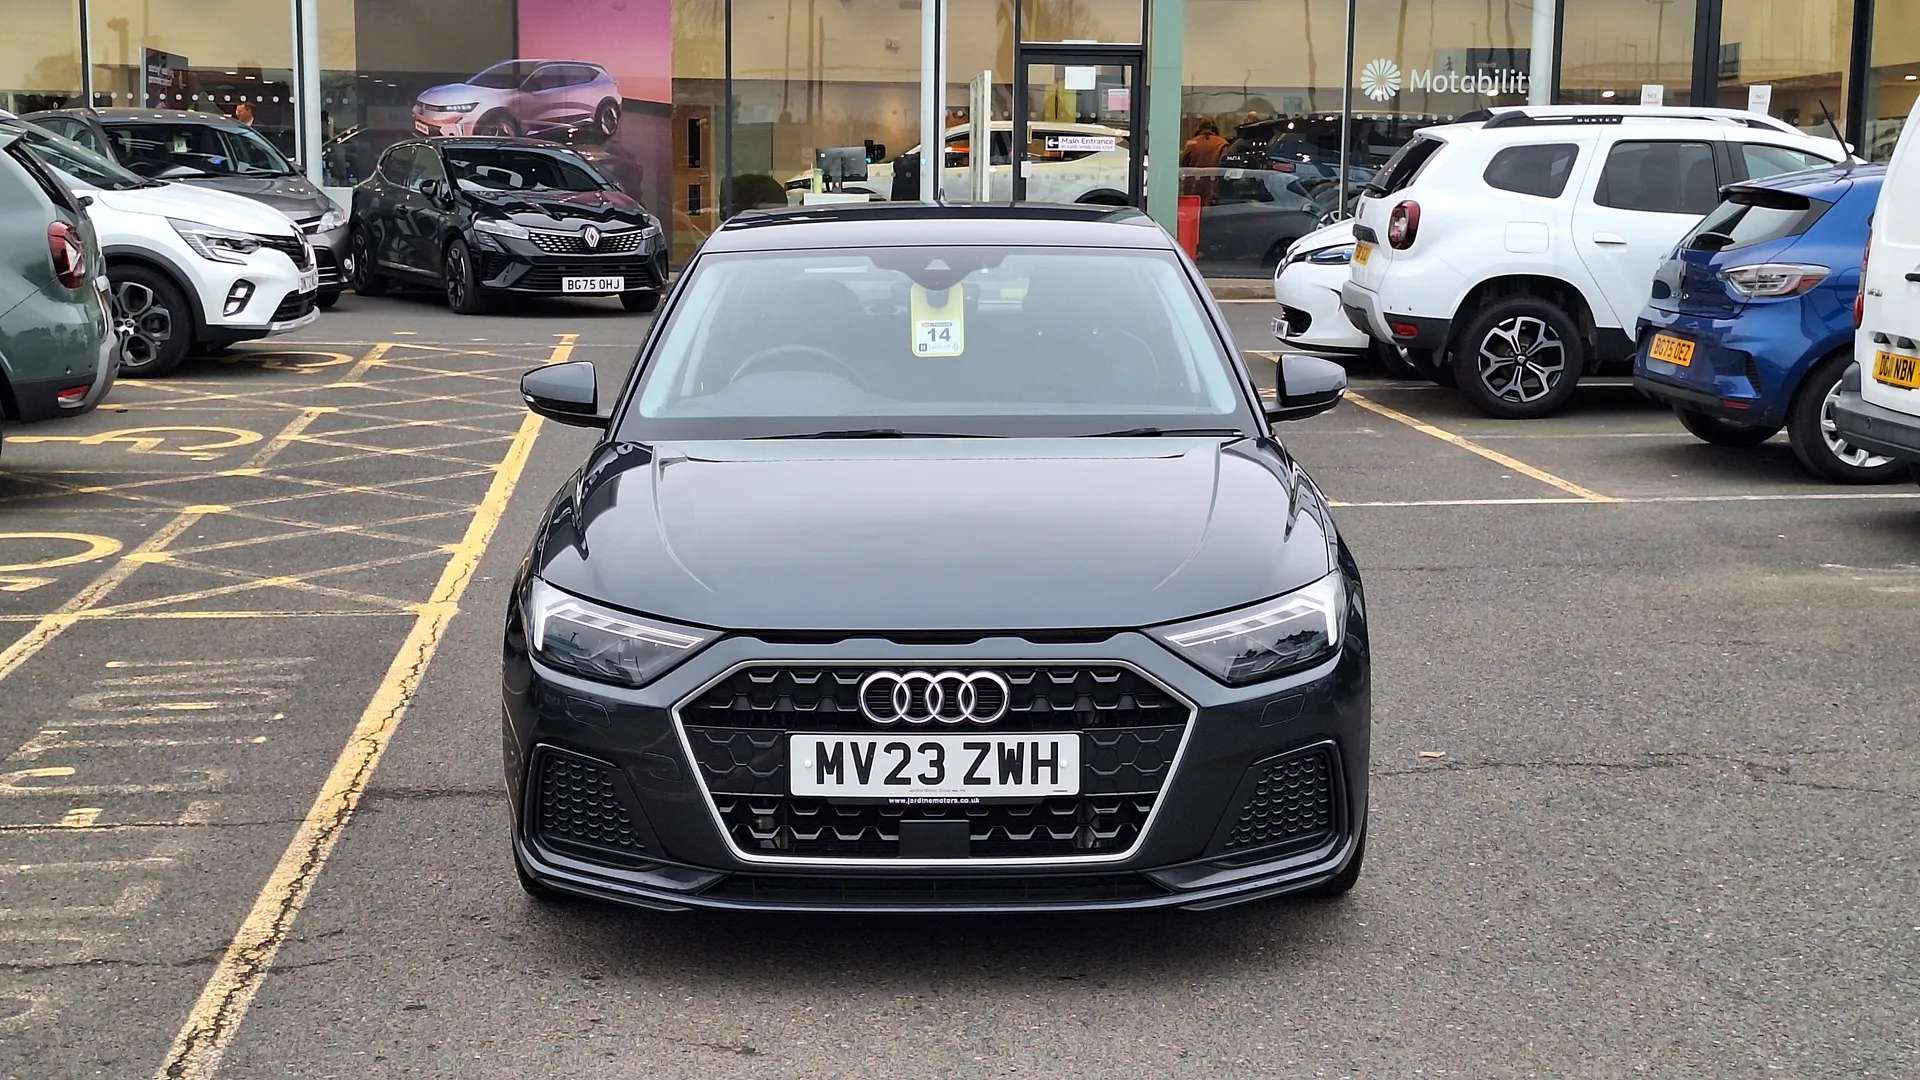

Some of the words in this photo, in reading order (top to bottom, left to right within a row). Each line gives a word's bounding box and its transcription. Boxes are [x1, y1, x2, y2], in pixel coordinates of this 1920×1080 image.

[1410, 69, 1531, 94] Motabilit
[567, 279, 596, 290] BG75
[598, 279, 620, 290] OHJ
[927, 328, 951, 342] 14
[1893, 358, 1916, 383] NBN
[815, 741, 946, 785] MV23
[962, 741, 1059, 785] ZWH
[889, 796, 980, 806] www.jardinemotors.co.uk
